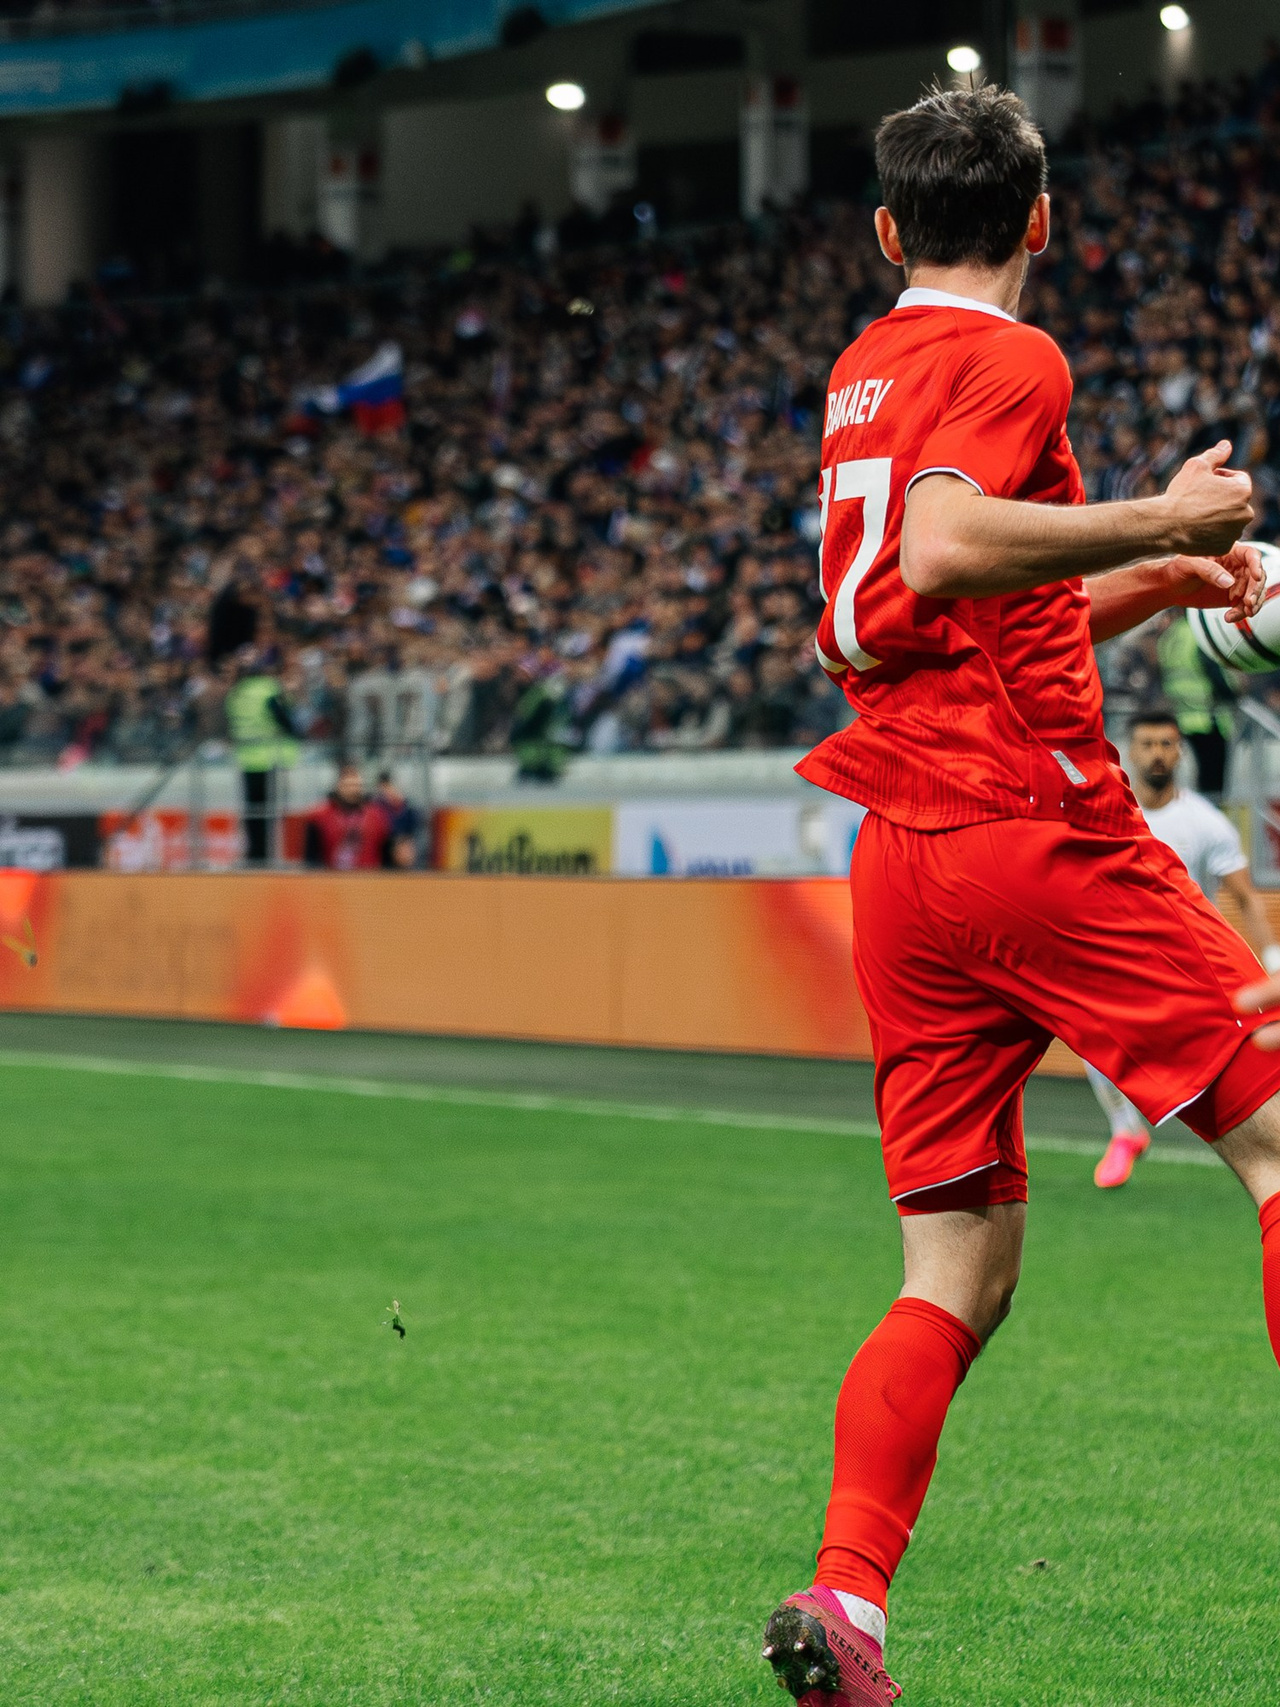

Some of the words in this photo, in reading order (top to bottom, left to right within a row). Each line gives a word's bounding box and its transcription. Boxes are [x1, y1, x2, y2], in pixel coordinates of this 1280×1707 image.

[824, 378, 895, 439] BAKAEV
[815, 457, 893, 673] 17
[829, 1629, 880, 1684] NEMESIS
